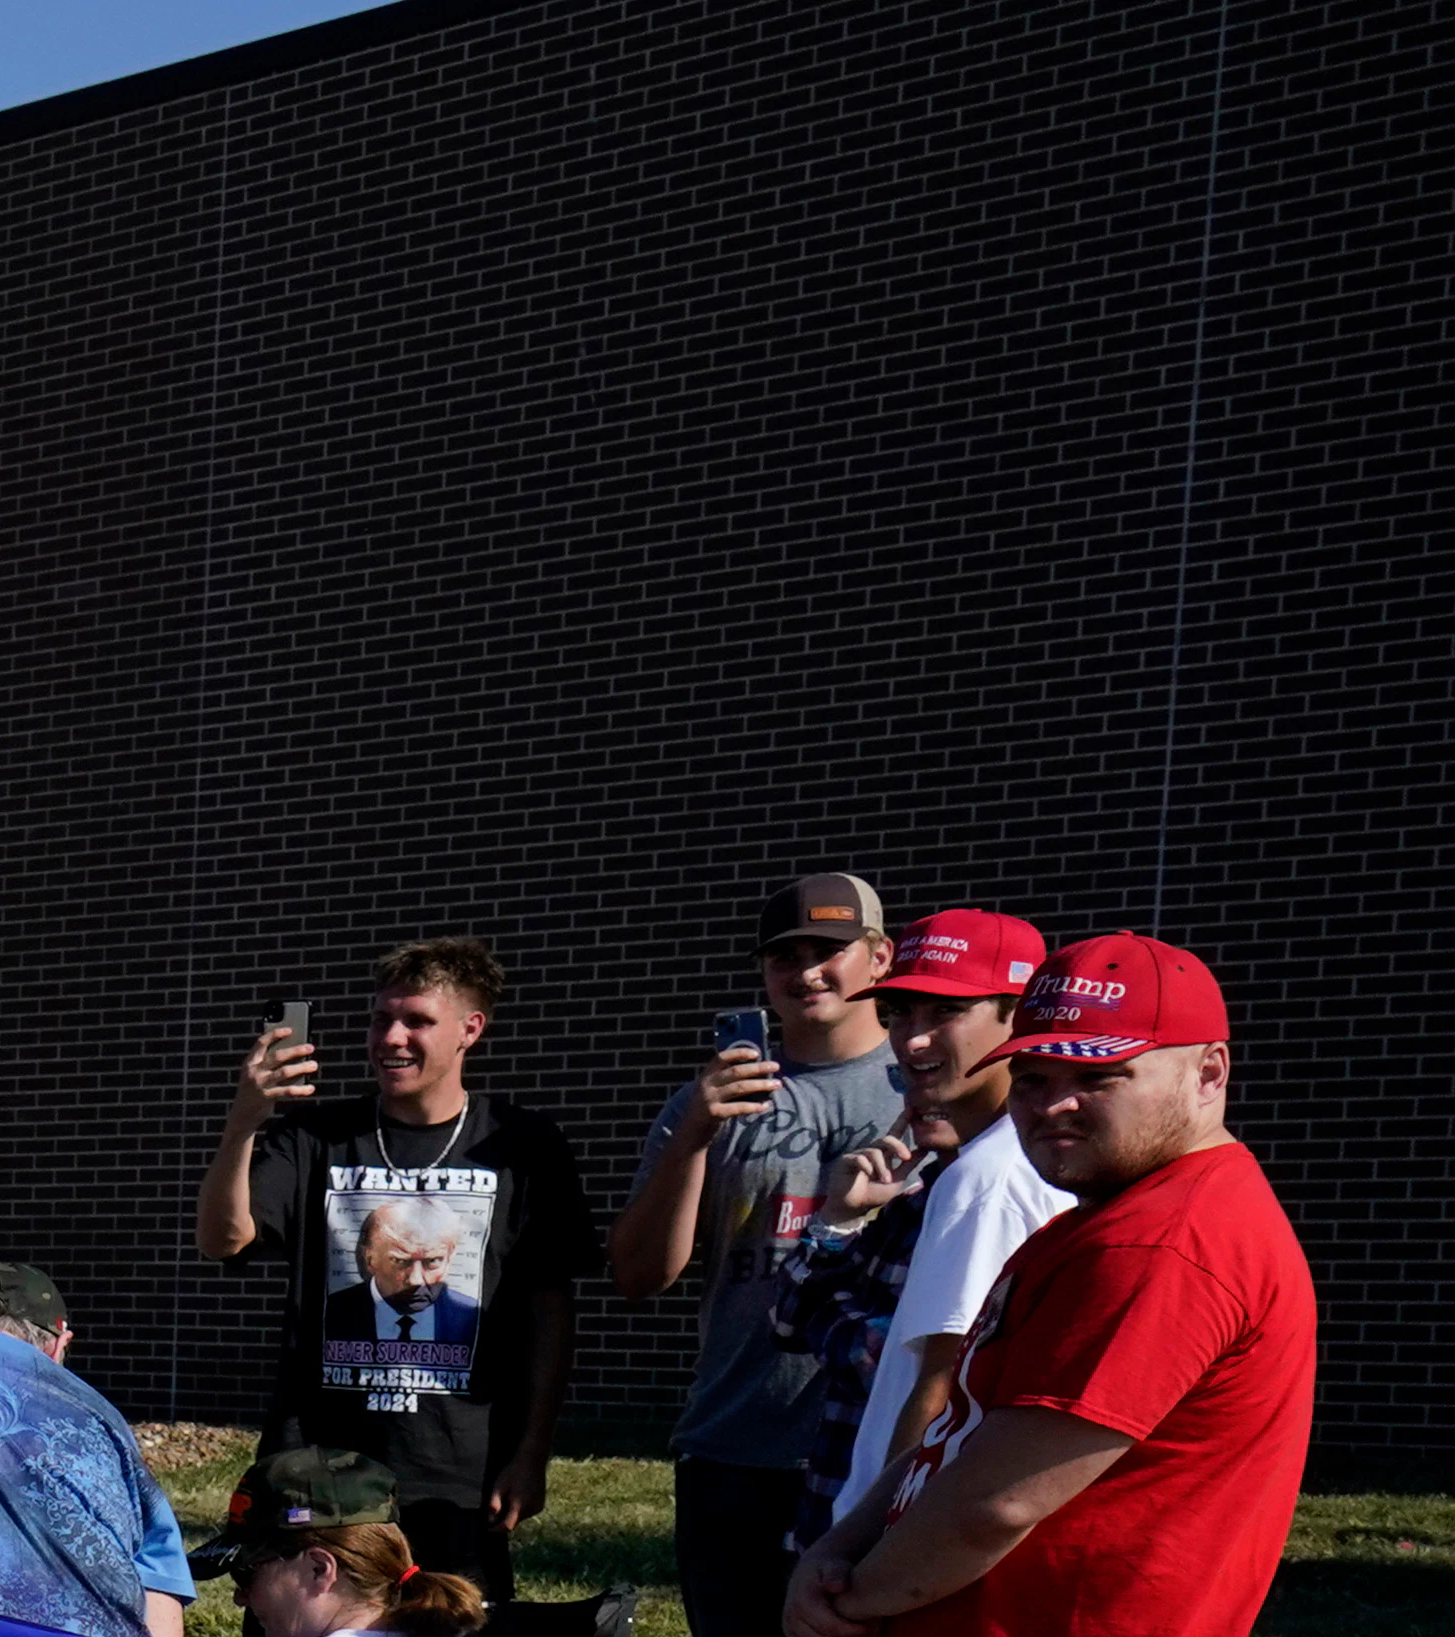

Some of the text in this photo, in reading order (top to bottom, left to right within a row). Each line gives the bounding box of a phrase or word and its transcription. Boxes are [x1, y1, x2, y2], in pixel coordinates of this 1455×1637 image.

[919, 935, 969, 952] AMERICA
[921, 949, 960, 964] AGAIN
[1030, 973, 1126, 1004] Trump
[1034, 1006, 1082, 1022] 2020
[735, 1108, 880, 1163] Coor
[329, 1165, 498, 1193] WANTED
[324, 1340, 470, 1366] NEVER SURRENDER
[322, 1366, 471, 1390] FOR PRESIDENT
[366, 1393, 419, 1414] 2024
